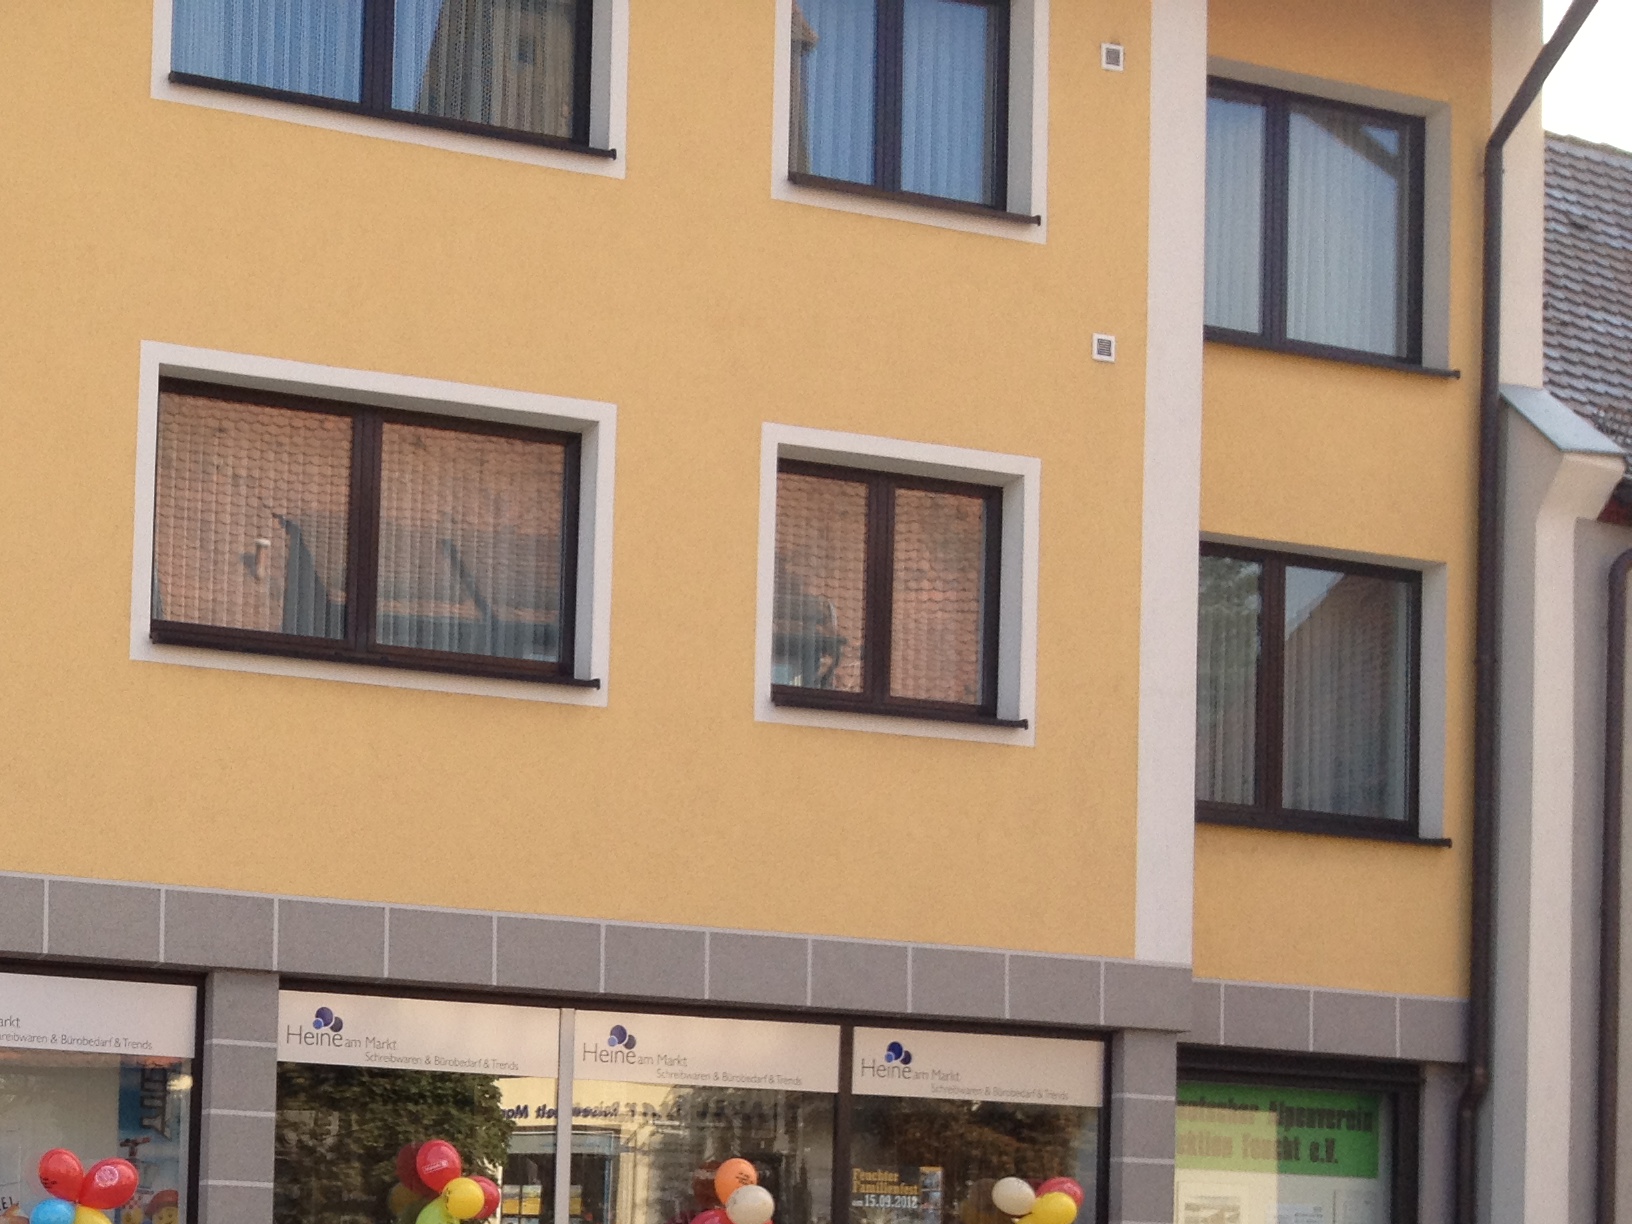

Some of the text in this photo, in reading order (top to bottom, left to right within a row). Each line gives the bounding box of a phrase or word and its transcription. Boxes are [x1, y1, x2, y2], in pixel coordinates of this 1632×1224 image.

[50, 1034, 58, 1044] &
[61, 1034, 113, 1048] Bürobedarf
[123, 1038, 153, 1050] Trends
[286, 1025, 397, 1050] Heine am Markt
[365, 1052, 422, 1065] Schreibwaren
[435, 1055, 482, 1068] Bürobedarf
[582, 1043, 687, 1067] Heine am Markt
[861, 1058, 960, 1082] Heine am Markt
[852, 1168, 899, 1182] Feuchter
[852, 1181, 919, 1194] Familienfest
[864, 1194, 918, 1209] 15.09.2012
